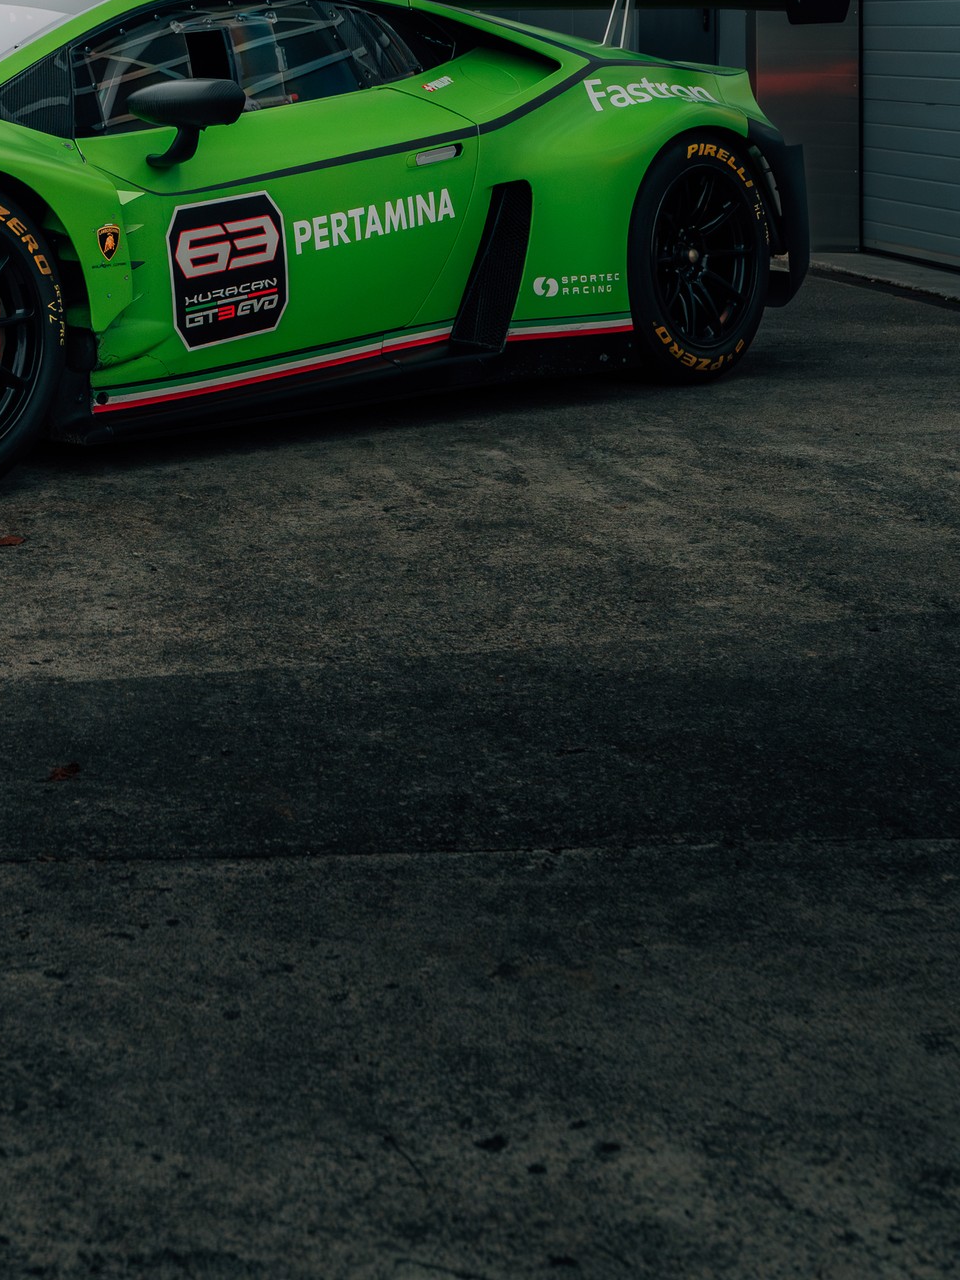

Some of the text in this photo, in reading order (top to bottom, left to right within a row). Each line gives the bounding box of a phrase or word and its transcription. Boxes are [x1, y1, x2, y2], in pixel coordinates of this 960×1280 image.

[583, 77, 720, 112] Fastron
[686, 142, 755, 188] PIRELLI
[292, 188, 456, 255] PERTAMINA
[175, 214, 280, 279] 63
[561, 272, 620, 284] SPORTEC
[562, 284, 613, 295] RACING
